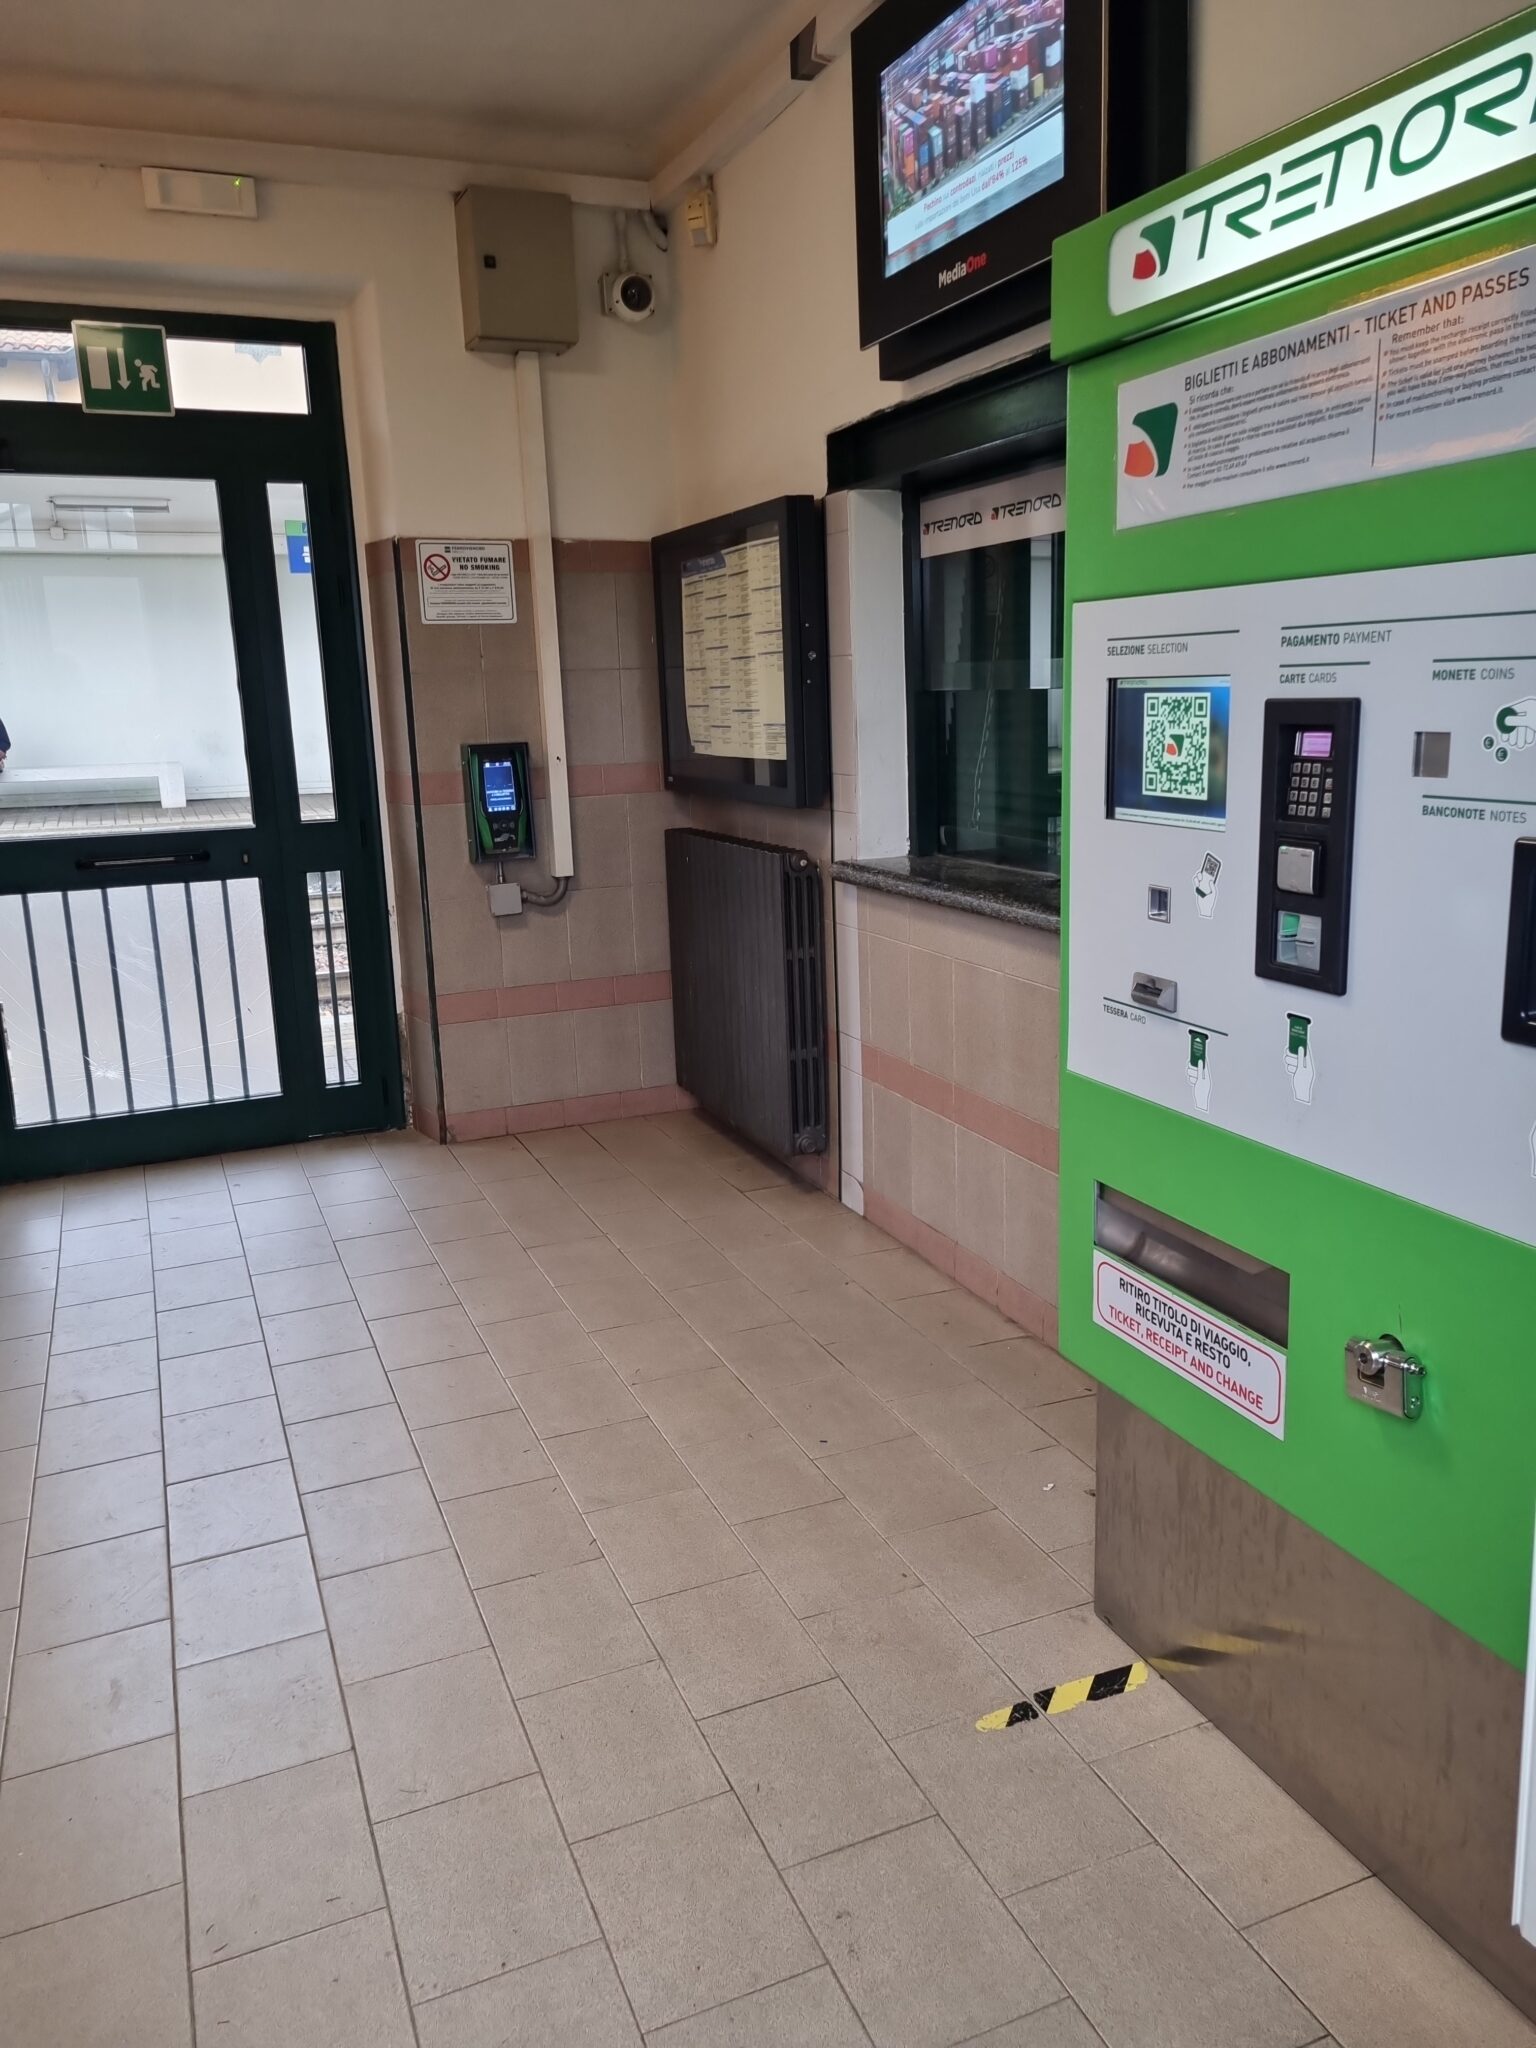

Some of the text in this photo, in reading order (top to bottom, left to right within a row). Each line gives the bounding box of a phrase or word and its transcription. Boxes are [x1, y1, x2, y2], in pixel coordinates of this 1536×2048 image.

[939, 252, 988, 288] MediaOne
[1184, 360, 1238, 391] BIGLIETTI
[1241, 357, 1248, 374] E
[1252, 325, 1349, 371] ABBONAMENTI
[1365, 303, 1416, 335] TICKET
[1421, 290, 1456, 318] AND
[1460, 266, 1529, 306] PASSES
[1391, 313, 1464, 344] Remember that:
[1000, 493, 1062, 519] TRENORD
[930, 511, 983, 534] TRENORD
[1107, 642, 1188, 656] SELEZIONE SELECTION
[1281, 630, 1392, 647] PAGAMENTO PAYMENT
[1279, 672, 1337, 684] CARTE CARDS
[1432, 667, 1515, 681] MONETE COINS
[1422, 805, 1527, 824] BANCONOTE NOTES
[1103, 1004, 1147, 1025] TESSERA CARD
[1119, 1277, 1251, 1367] RITIRO TITOLO DI VIAGGIO,
[1135, 1302, 1231, 1369] RICEVUTA E RESTO
[1145, 1327, 1188, 1363] RECEIPT
[1190, 1355, 1214, 1379] AND
[1216, 1371, 1263, 1411] CHANGE
